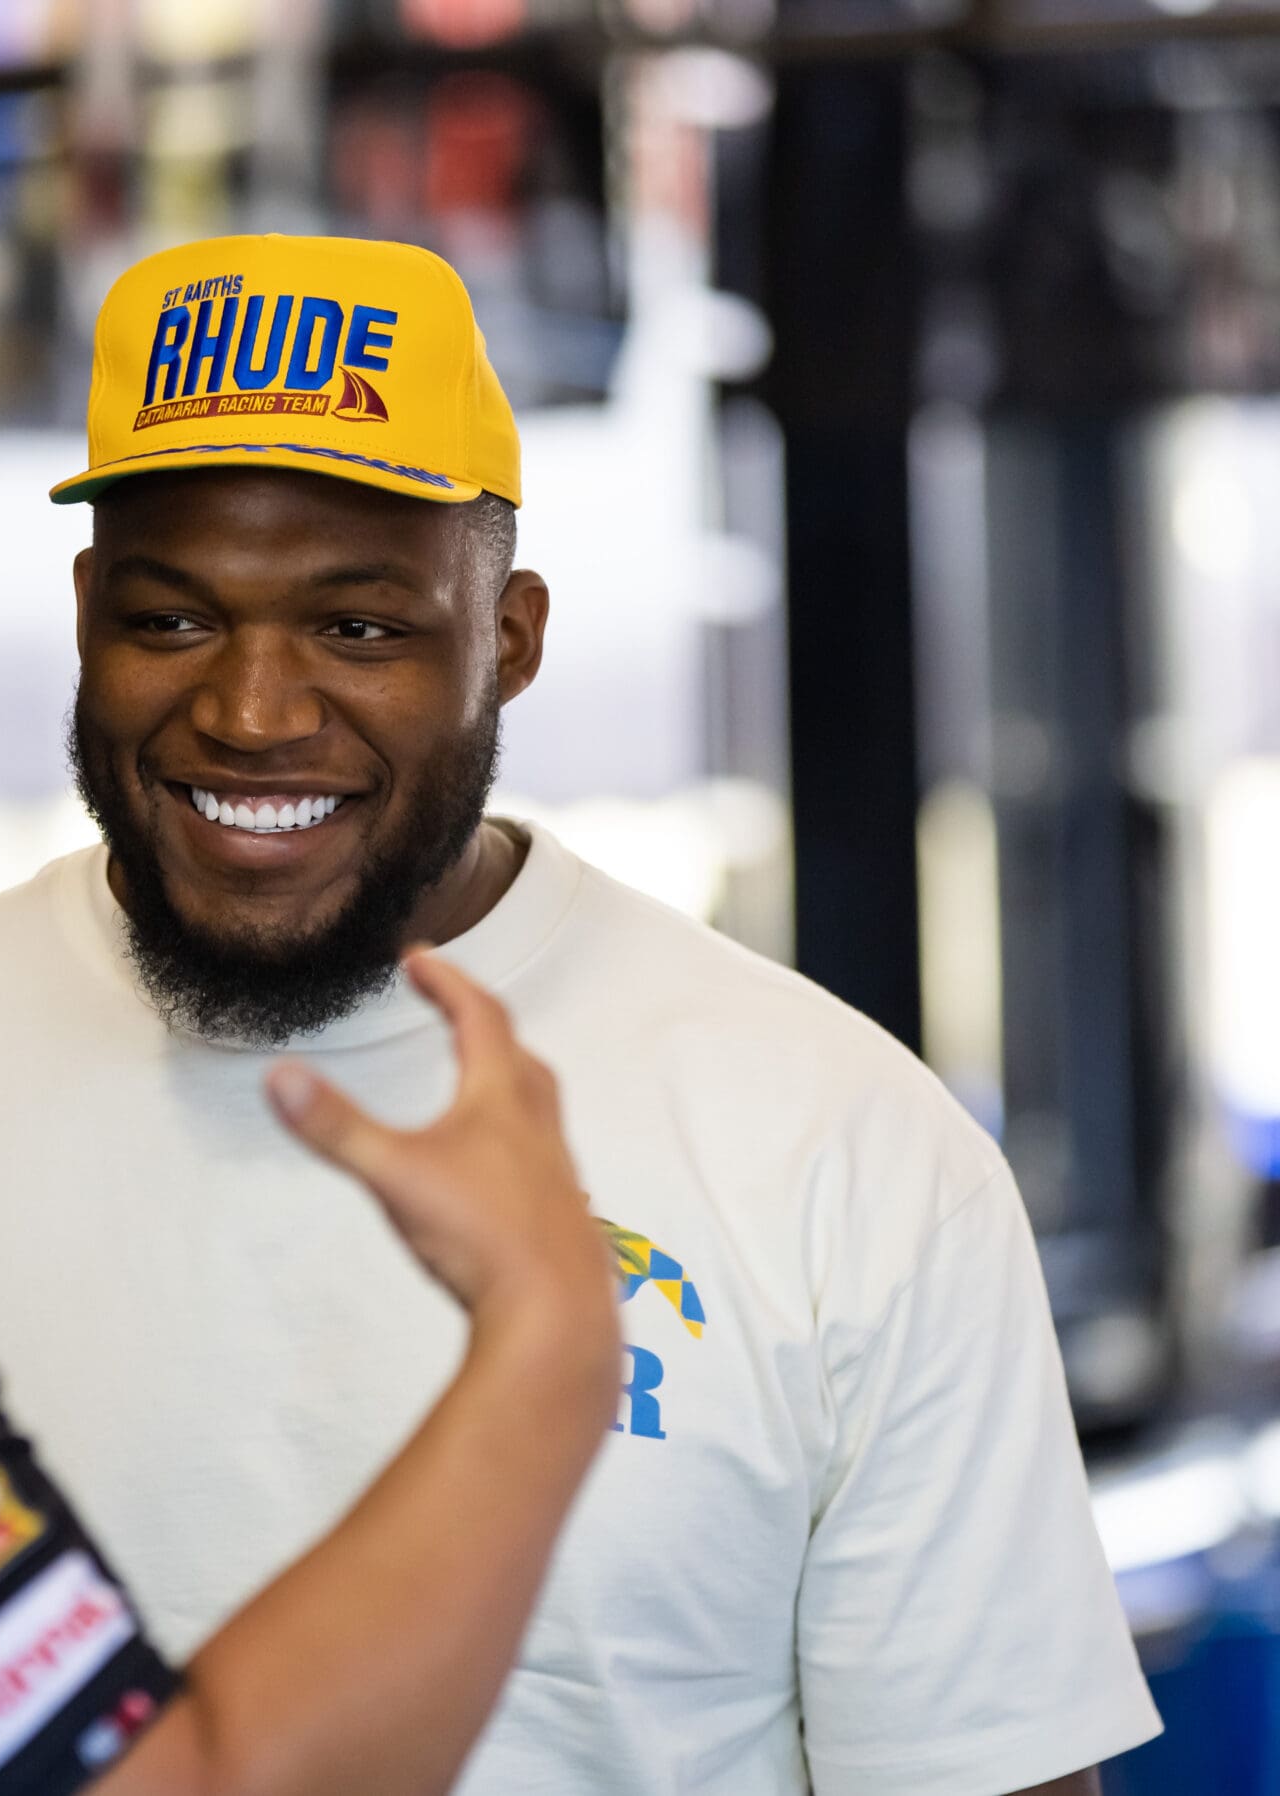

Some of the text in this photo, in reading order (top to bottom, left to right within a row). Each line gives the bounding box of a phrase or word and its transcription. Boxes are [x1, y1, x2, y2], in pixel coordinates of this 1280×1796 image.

[162, 274, 244, 309] ST BARTHS
[143, 295, 399, 408] RHUDE
[136, 395, 329, 429] CATAMARAN RACING TEAM
